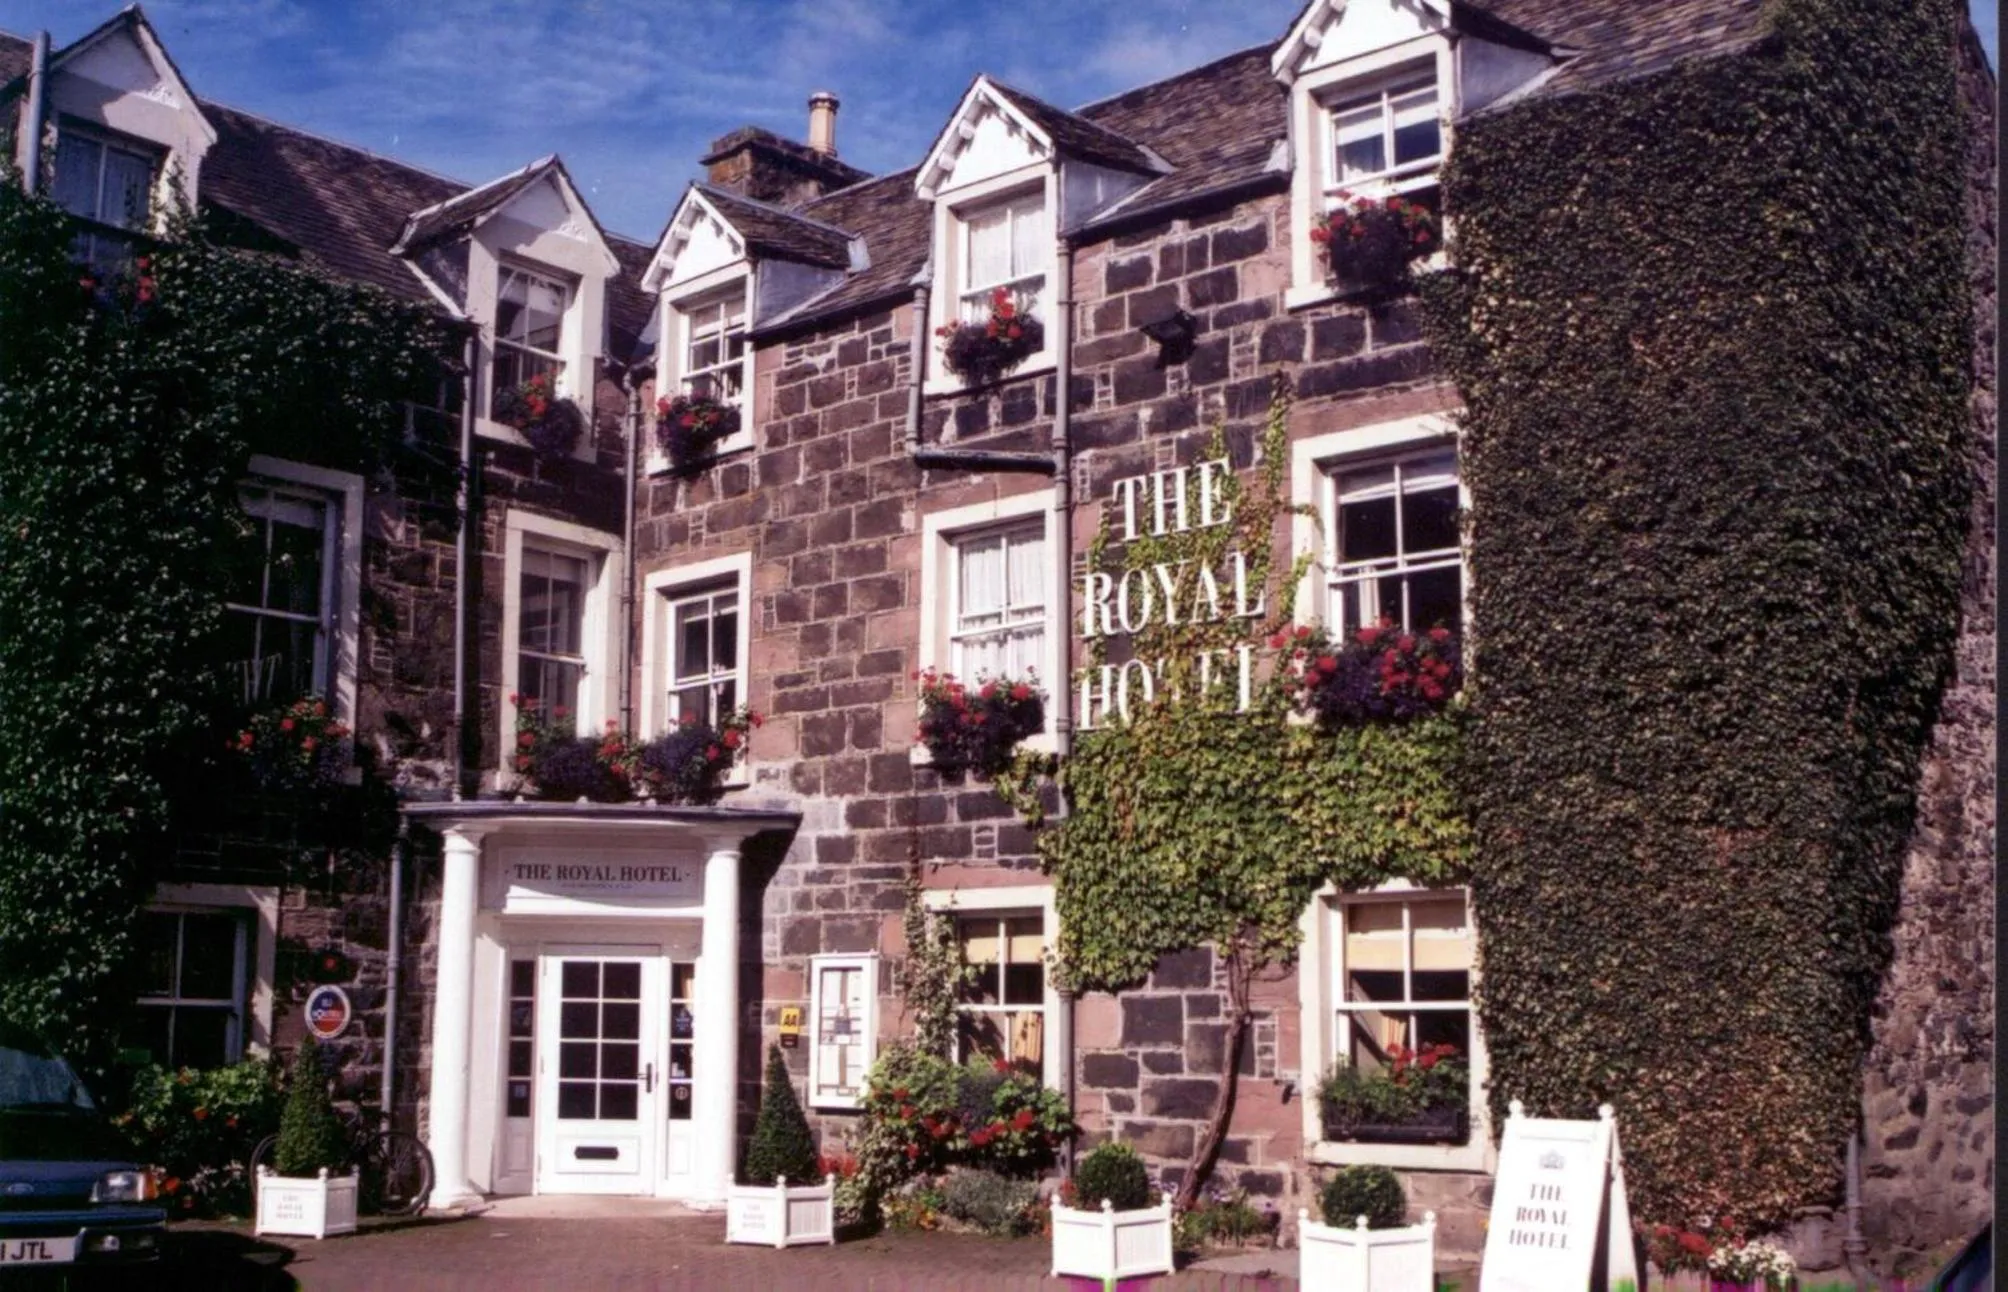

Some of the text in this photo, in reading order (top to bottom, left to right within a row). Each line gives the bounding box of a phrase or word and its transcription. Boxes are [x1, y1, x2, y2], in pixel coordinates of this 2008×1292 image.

[1112, 457, 1231, 542] THE
[1080, 550, 1266, 638] ROYAL
[1074, 644, 1257, 732] HOEL
[513, 863, 682, 883] THE ROYAL HOTEL
[1529, 1183, 1564, 1201] THE
[1515, 1206, 1572, 1226] ROYAL
[1508, 1228, 1572, 1250] HOTEL
[11, 1241, 53, 1260] JTL
